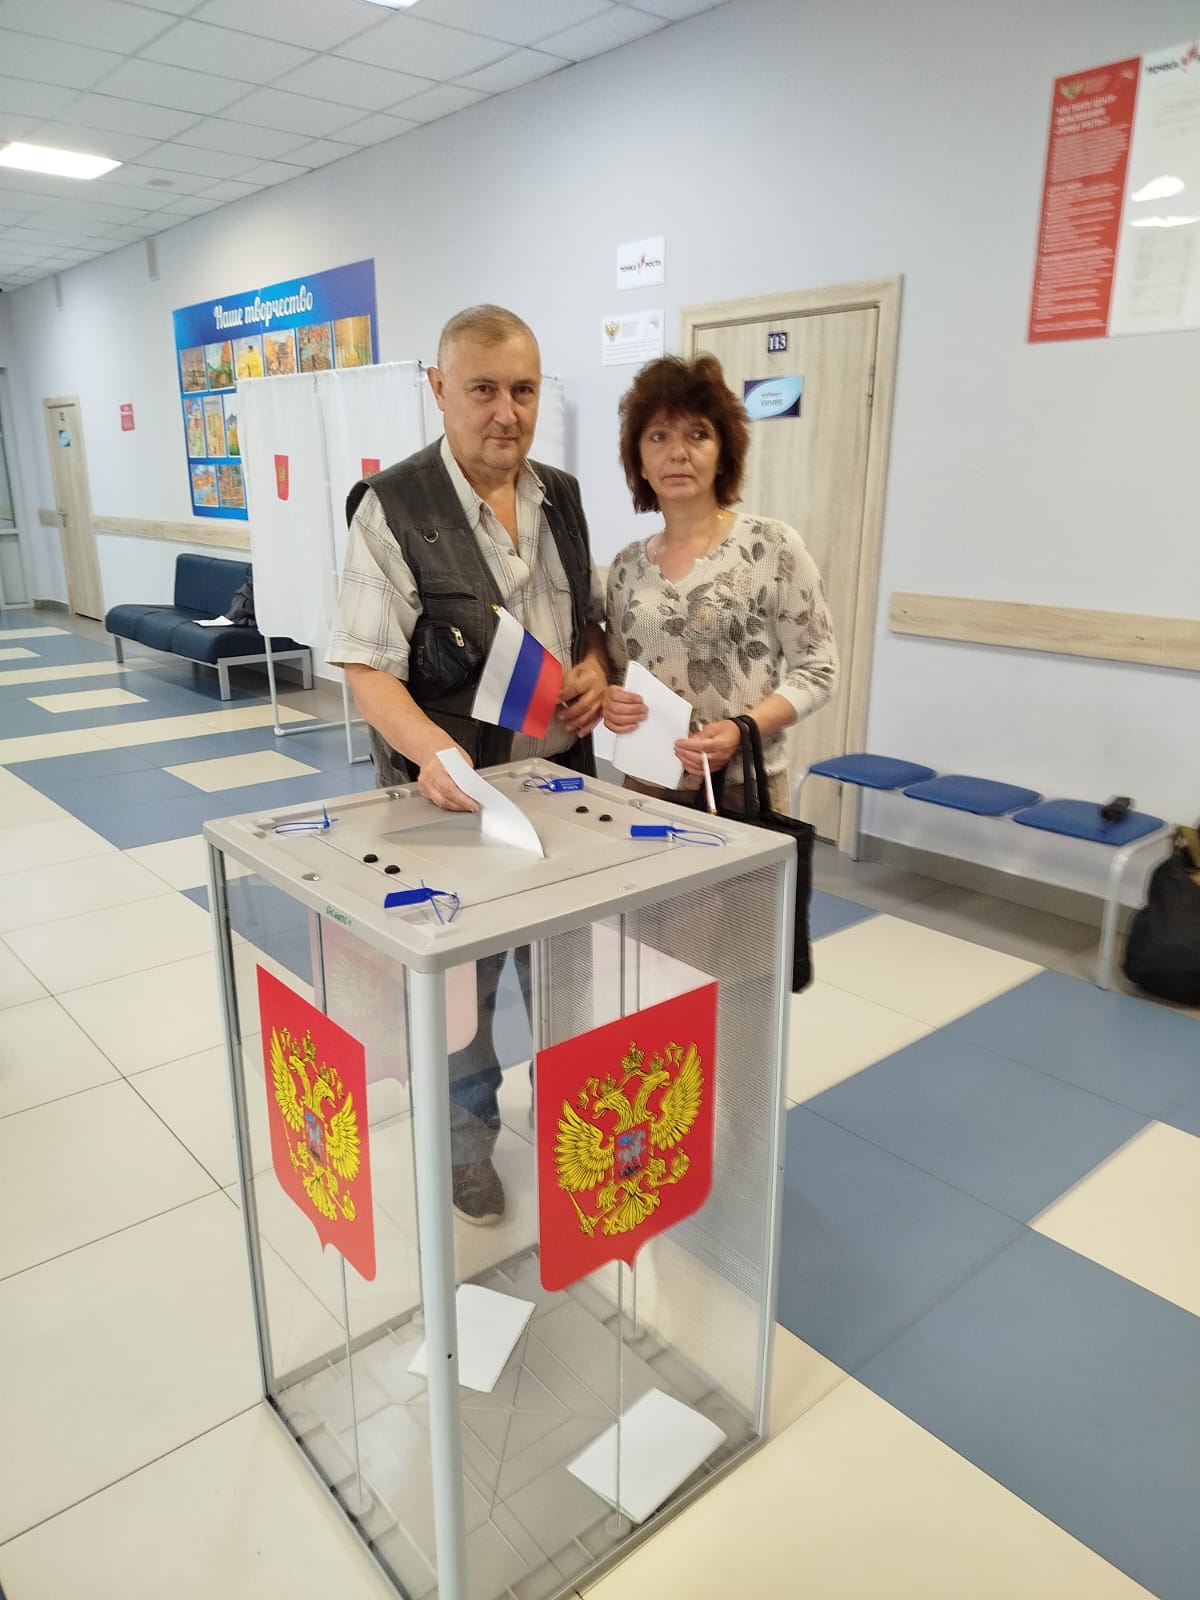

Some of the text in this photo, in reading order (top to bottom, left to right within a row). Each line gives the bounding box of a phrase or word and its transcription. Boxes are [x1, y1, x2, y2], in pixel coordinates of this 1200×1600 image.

[214, 285, 313, 330] Наше творчество
[768, 333, 786, 350] 113
